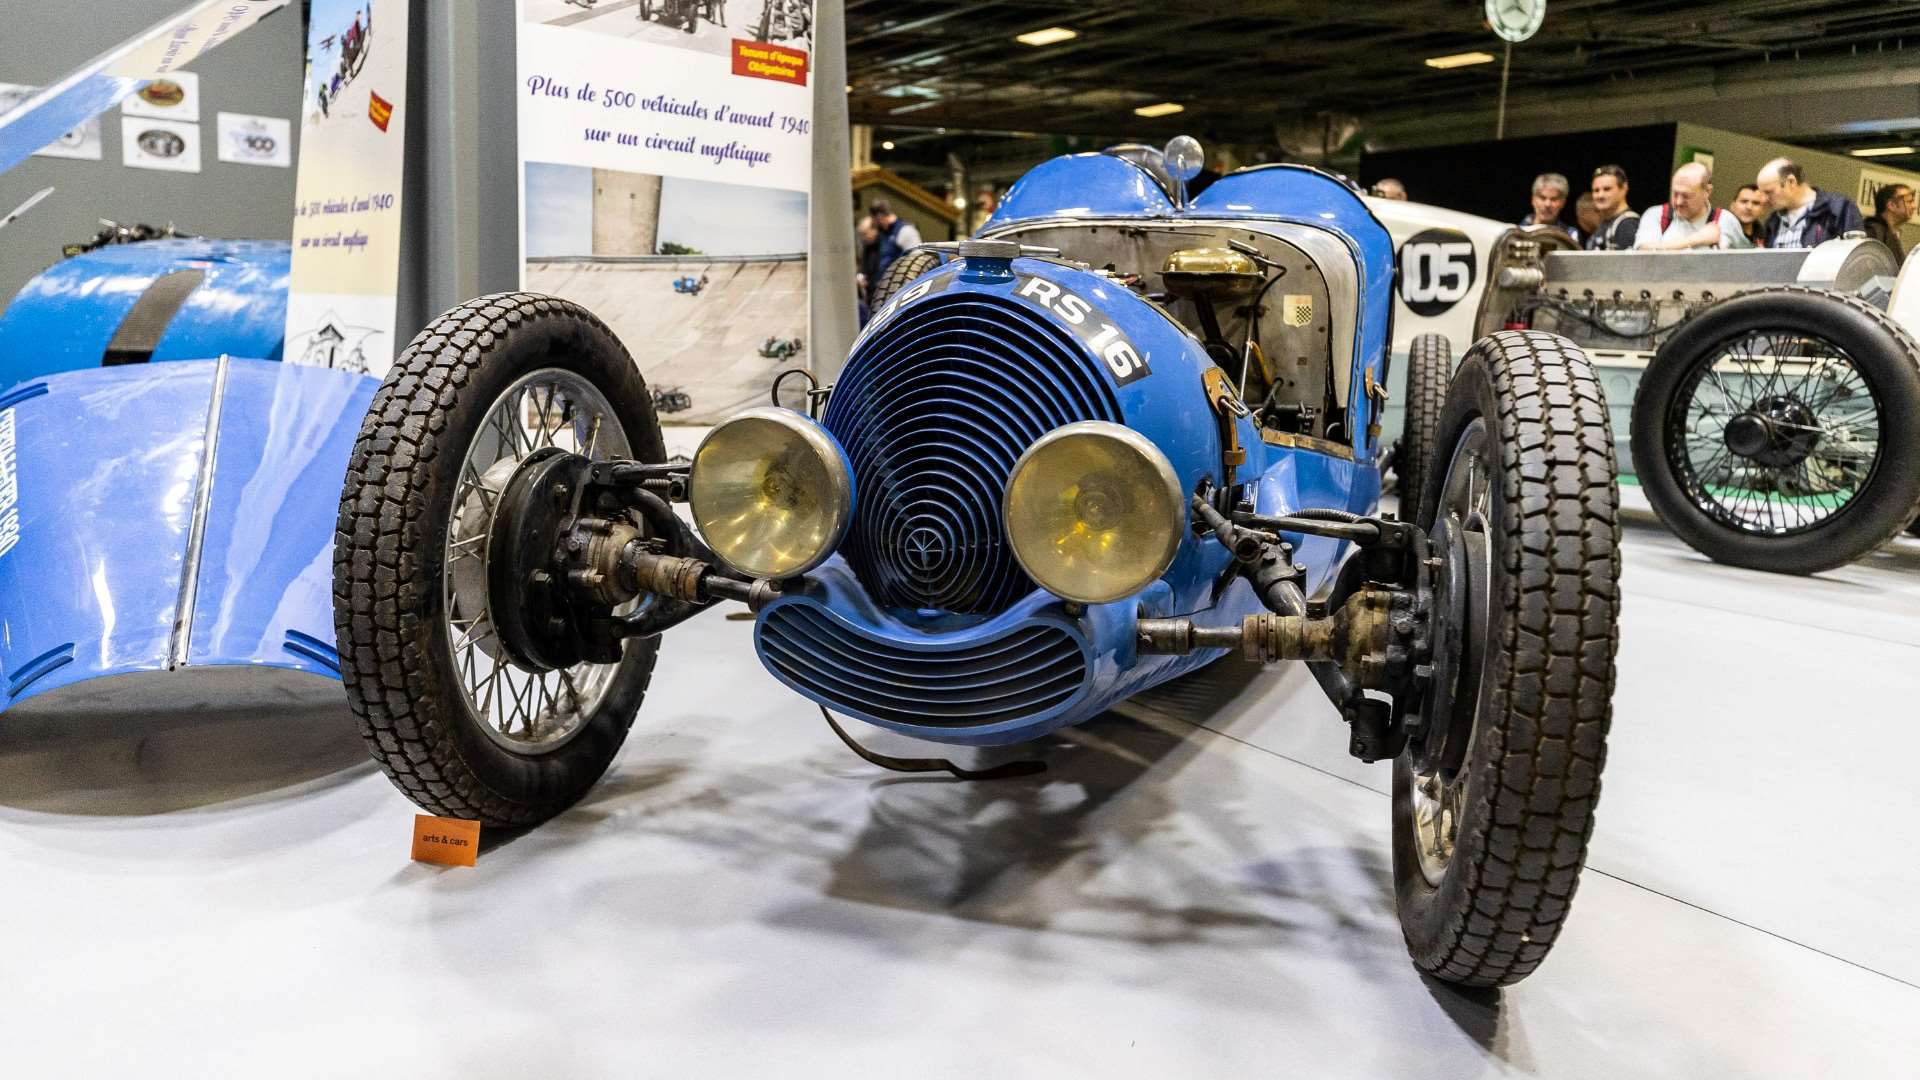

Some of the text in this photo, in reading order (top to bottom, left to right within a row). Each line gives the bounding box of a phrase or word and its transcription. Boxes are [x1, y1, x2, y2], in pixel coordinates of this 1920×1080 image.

[527, 75, 569, 99] Plus
[577, 83, 596, 102] de
[603, 89, 636, 108] 500
[714, 105, 774, 128] d'avant
[584, 128, 771, 168] sur un circuit mythique
[1402, 242, 1473, 303] 105
[1020, 277, 1092, 325] RS
[1088, 323, 1143, 378] 16
[422, 834, 468, 847] arts & cars
